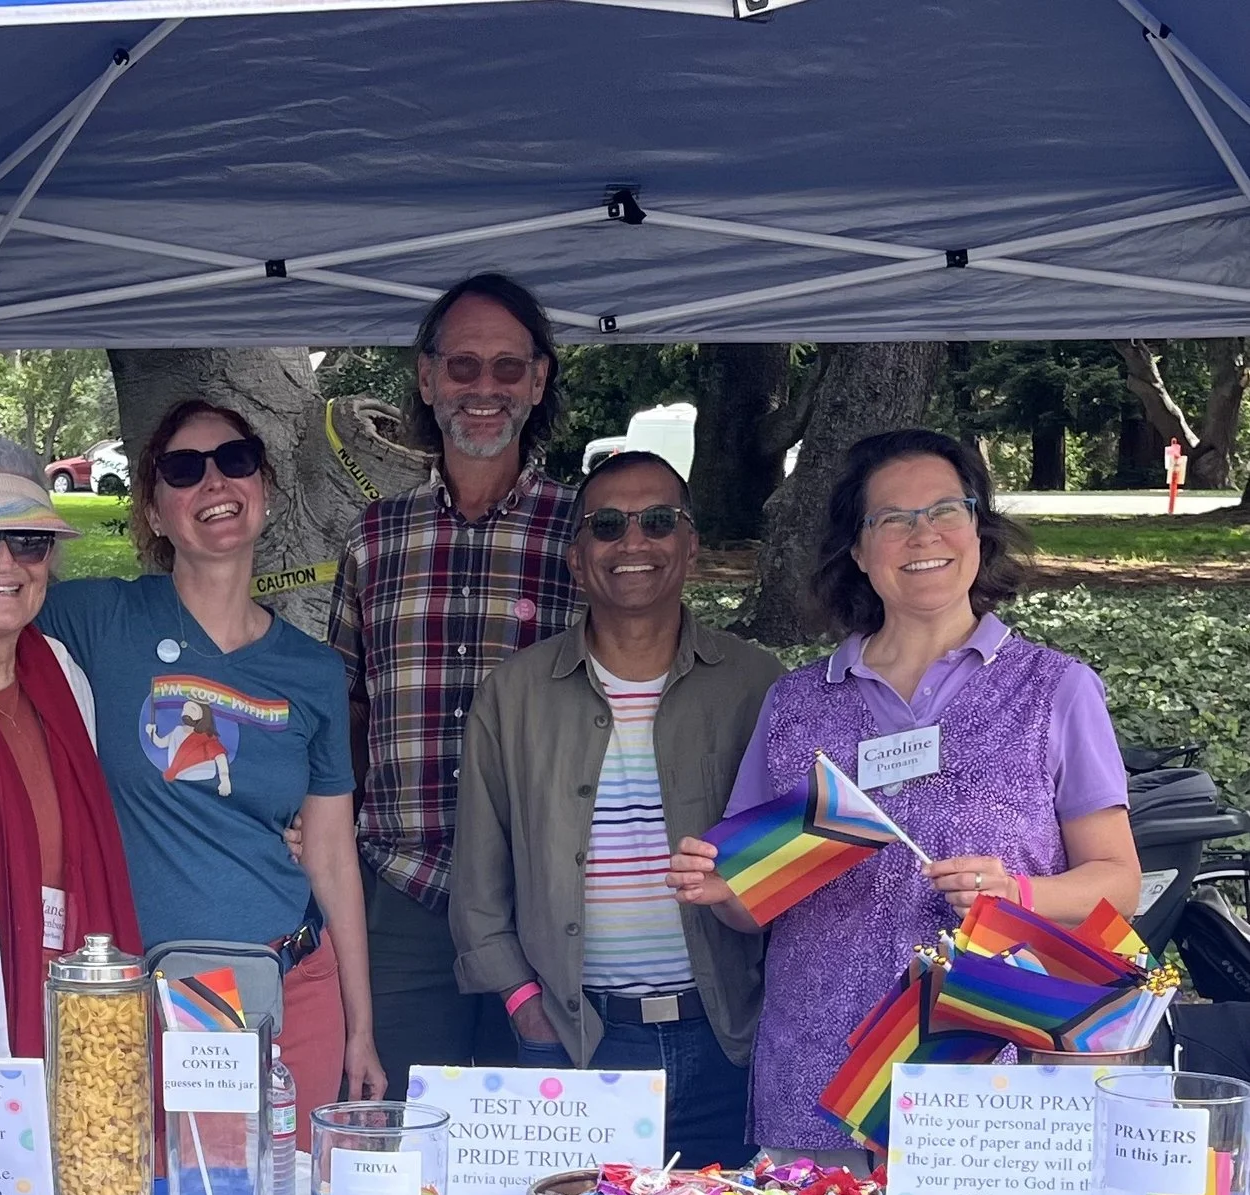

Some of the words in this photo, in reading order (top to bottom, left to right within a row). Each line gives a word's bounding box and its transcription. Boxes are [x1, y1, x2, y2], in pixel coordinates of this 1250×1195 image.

[256, 567, 317, 594] CAUTION
[864, 740, 932, 762] Caroline
[877, 757, 918, 772] Putnam
[191, 1045, 230, 1056] PASTA
[181, 1059, 240, 1070] CONTEST
[165, 1079, 202, 1090] guesses
[204, 1078, 215, 1089] in
[217, 1078, 236, 1089] this
[469, 1097, 522, 1115] TEST
[527, 1099, 590, 1118] YOUR
[902, 1091, 970, 1108] SHARE
[975, 1093, 1034, 1110] YOUR
[902, 1113, 943, 1127] Write
[946, 1118, 981, 1131] your
[984, 1117, 1046, 1133] personal
[1051, 1121, 1093, 1136] praye
[1114, 1122, 1196, 1144] PRAYERS
[587, 1127, 616, 1144] OF
[904, 1135, 913, 1146] a
[917, 1132, 956, 1149] piece
[959, 1134, 978, 1148] of
[979, 1138, 1021, 1153] paper
[1024, 1137, 1051, 1151] and
[1055, 1138, 1083, 1152] add
[457, 1148, 519, 1166] PRIDE
[524, 1150, 599, 1168] TRIVIA
[907, 1152, 929, 1166] the
[930, 1152, 956, 1170] jar.
[961, 1154, 990, 1168] Our
[993, 1155, 1040, 1174] clergy
[1044, 1157, 1073, 1171] will
[1115, 1143, 1127, 1158] in
[1131, 1147, 1159, 1163] this
[1162, 1149, 1192, 1167] jar.
[354, 1162, 398, 1174] TRIVIA
[451, 1174, 460, 1184] a
[463, 1172, 496, 1185] trivia
[915, 1175, 950, 1189] your
[953, 1176, 1001, 1191] prayer
[1005, 1177, 1019, 1189] to
[1024, 1176, 1056, 1191] God
[1060, 1177, 1075, 1191] in
